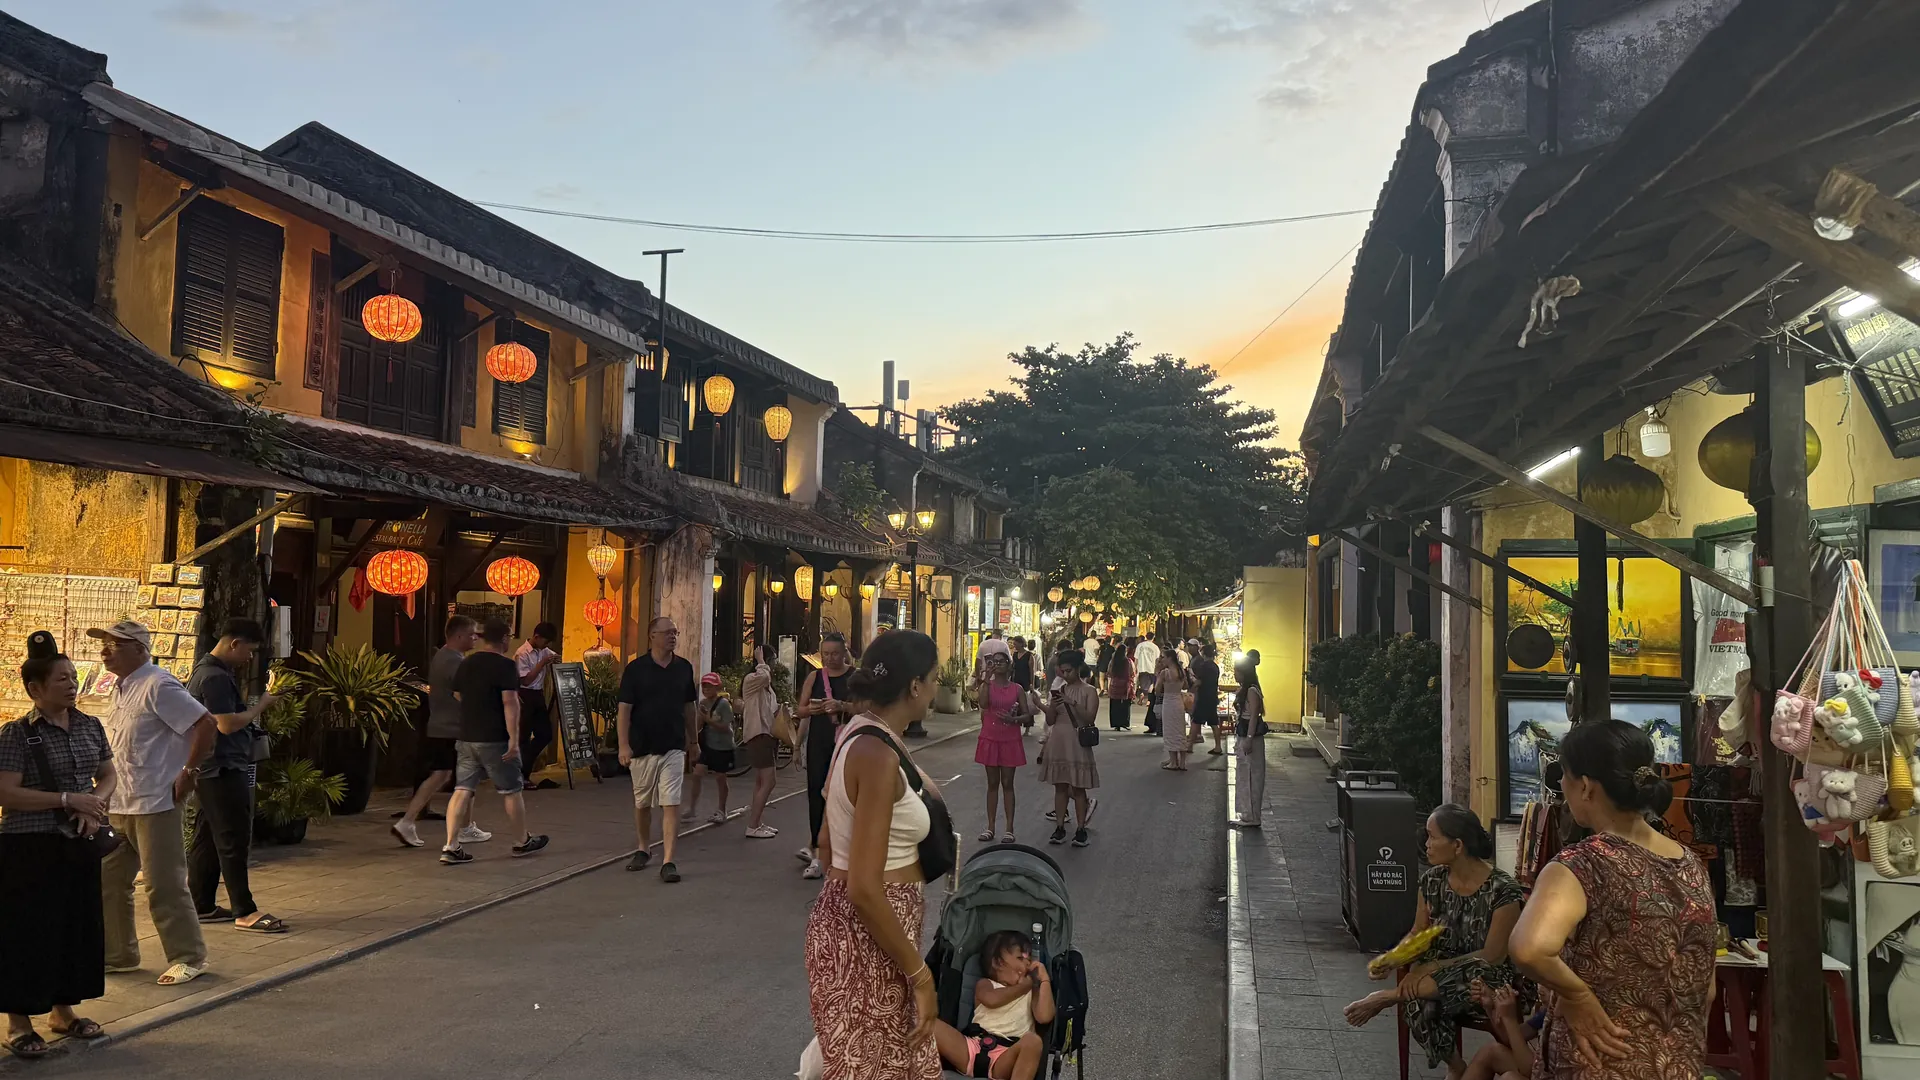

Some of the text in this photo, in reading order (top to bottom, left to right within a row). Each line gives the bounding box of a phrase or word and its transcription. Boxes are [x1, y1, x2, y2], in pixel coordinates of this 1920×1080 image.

[381, 520, 428, 535] TRONELLA
[1710, 608, 1729, 617] Good
[1709, 645, 1746, 654] VIETNA
[1371, 870, 1382, 878] HÃY
